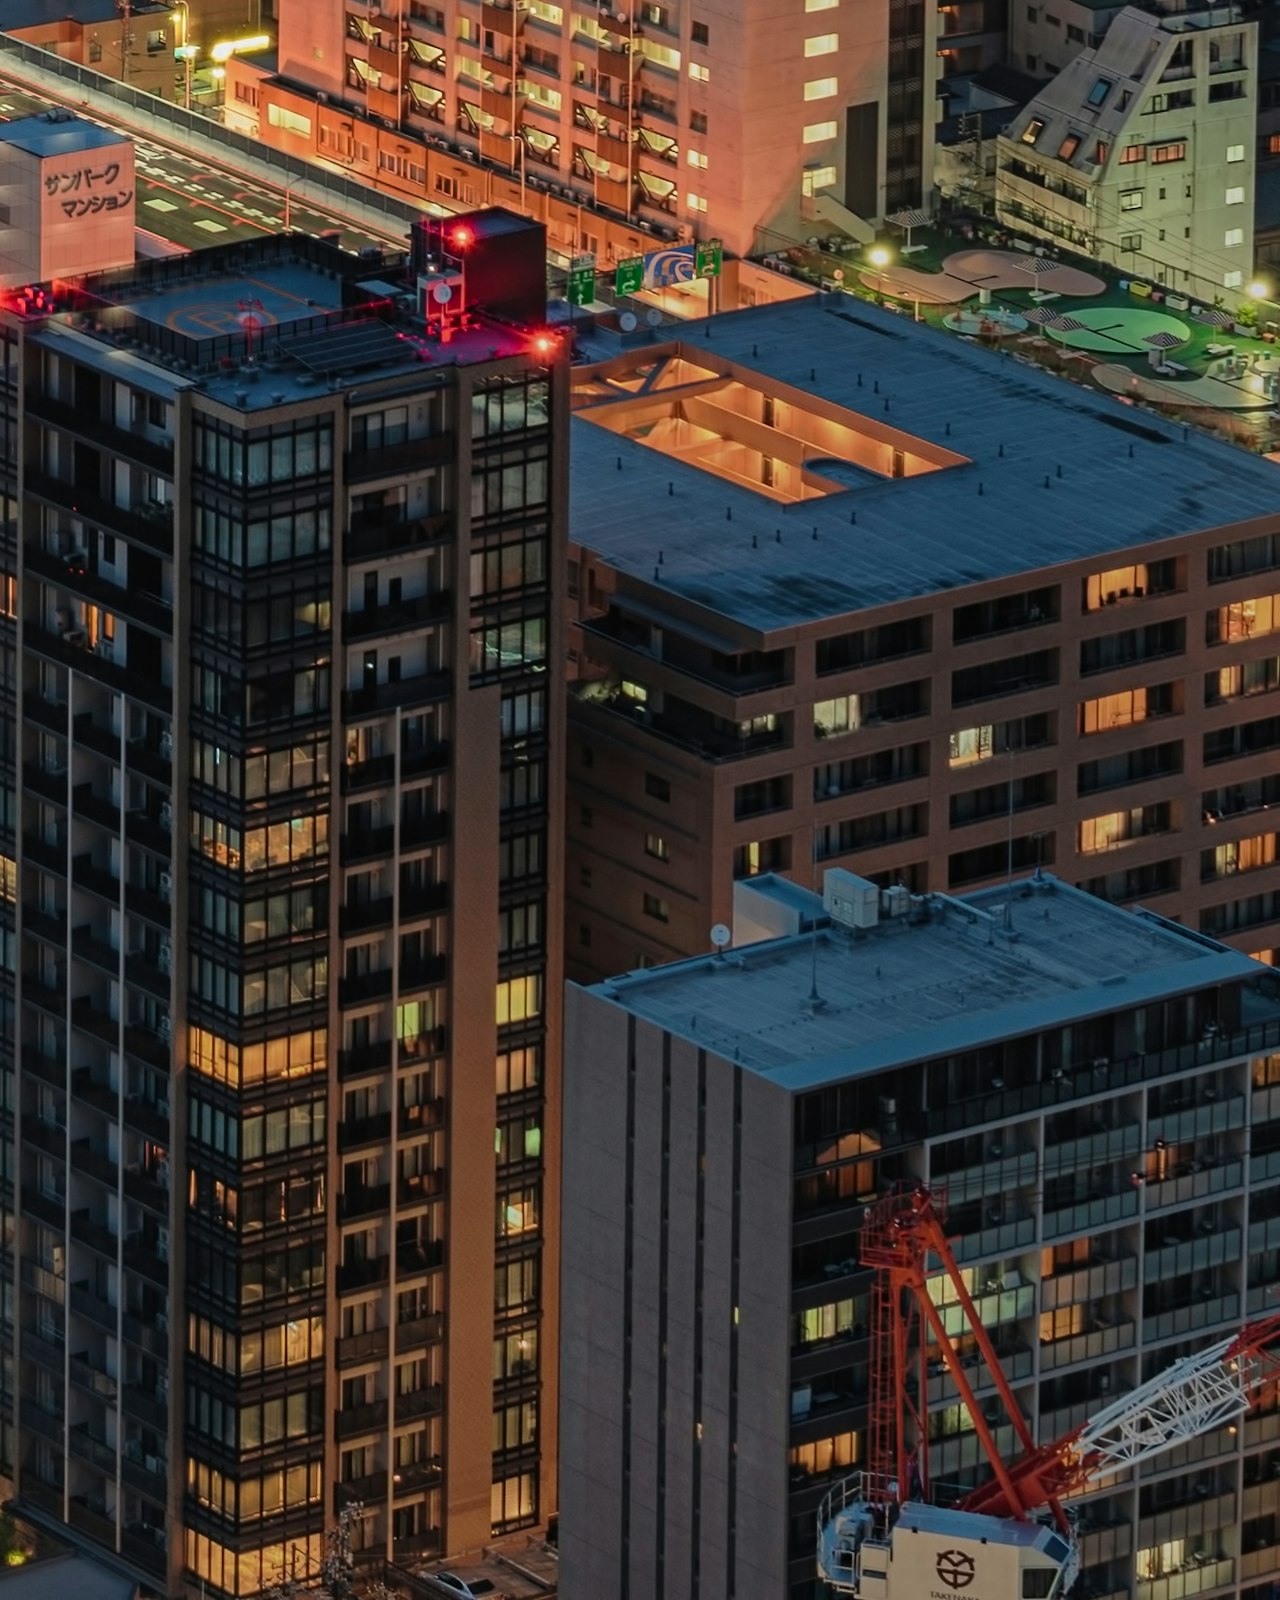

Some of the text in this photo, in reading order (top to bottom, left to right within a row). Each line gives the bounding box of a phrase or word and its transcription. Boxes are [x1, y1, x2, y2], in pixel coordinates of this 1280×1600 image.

[61, 190, 134, 218] マンション
